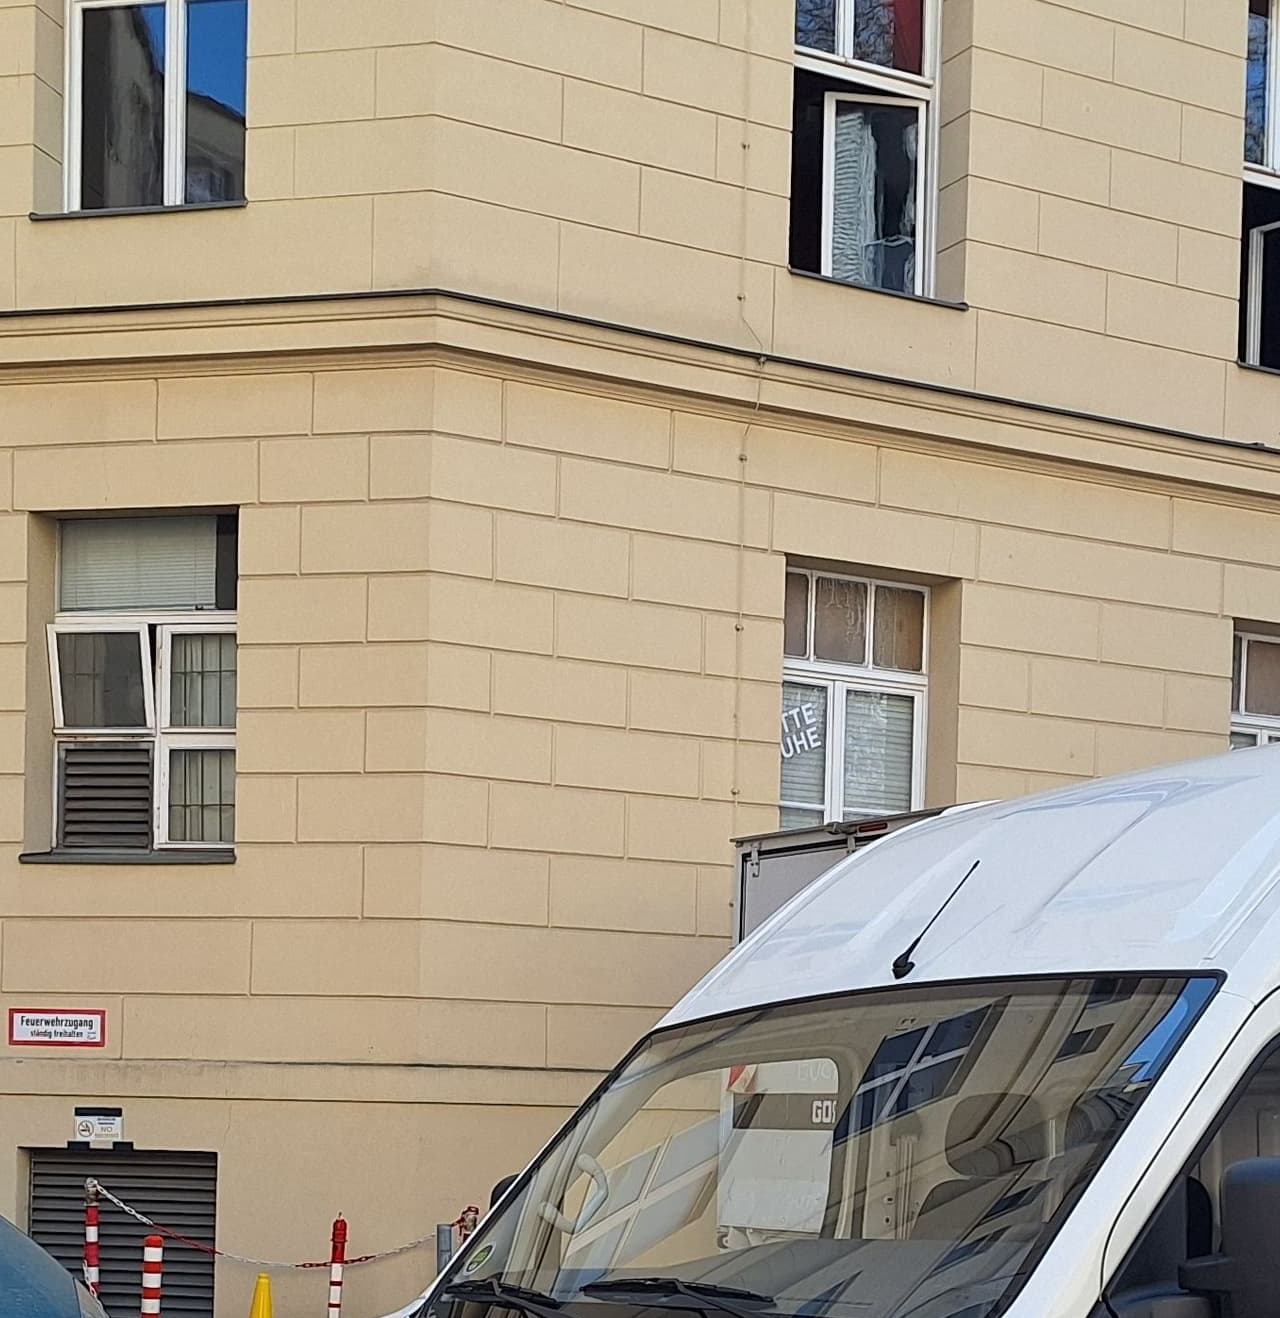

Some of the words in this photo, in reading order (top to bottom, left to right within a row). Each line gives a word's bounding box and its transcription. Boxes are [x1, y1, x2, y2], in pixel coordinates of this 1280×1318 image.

[780, 727, 821, 757] UHE
[20, 1016, 94, 1030] Feuerwehrzugang
[30, 1029, 52, 1039] ständig
[53, 1029, 84, 1038] freihalten
